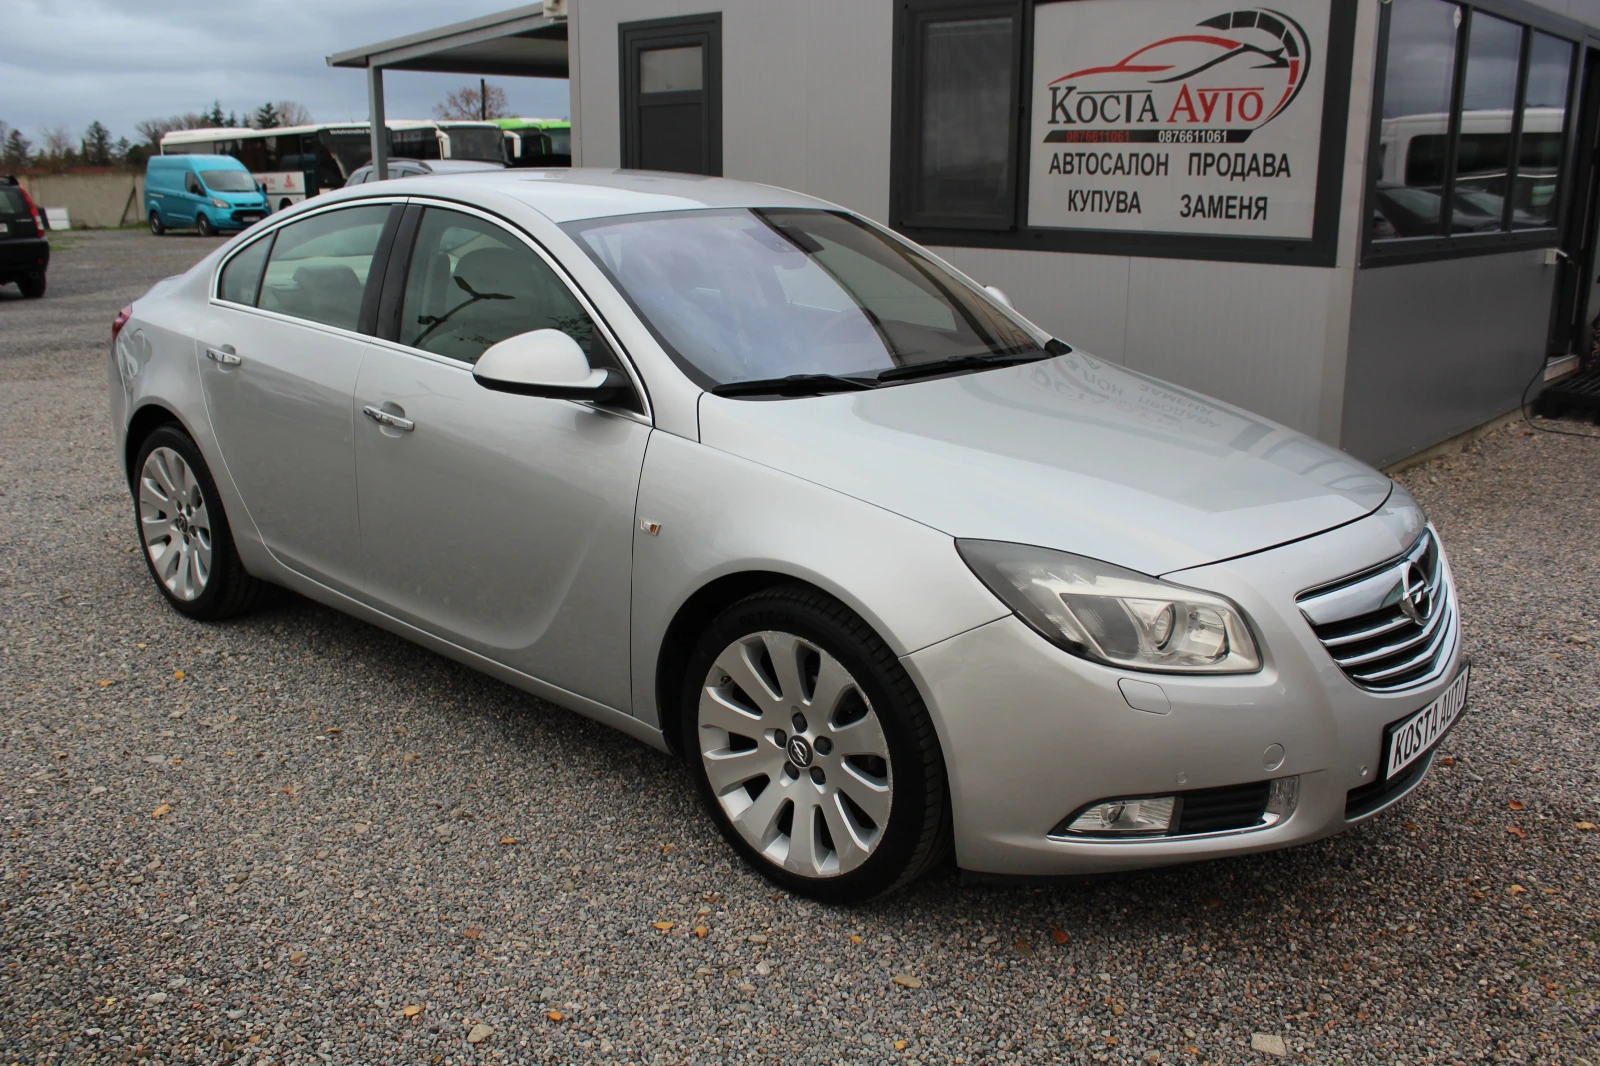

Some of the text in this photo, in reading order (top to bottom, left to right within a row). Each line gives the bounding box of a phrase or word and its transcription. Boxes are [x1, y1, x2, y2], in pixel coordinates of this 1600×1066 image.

[1066, 130, 1228, 143] 0876611061 0876611061
[1049, 152, 1291, 181] АВТОСАЛОН ПРОДАВА
[1067, 189, 1268, 220] КУПУВА ЗАМЕНЯ
[1392, 674, 1465, 770] KOSTA AUTO
